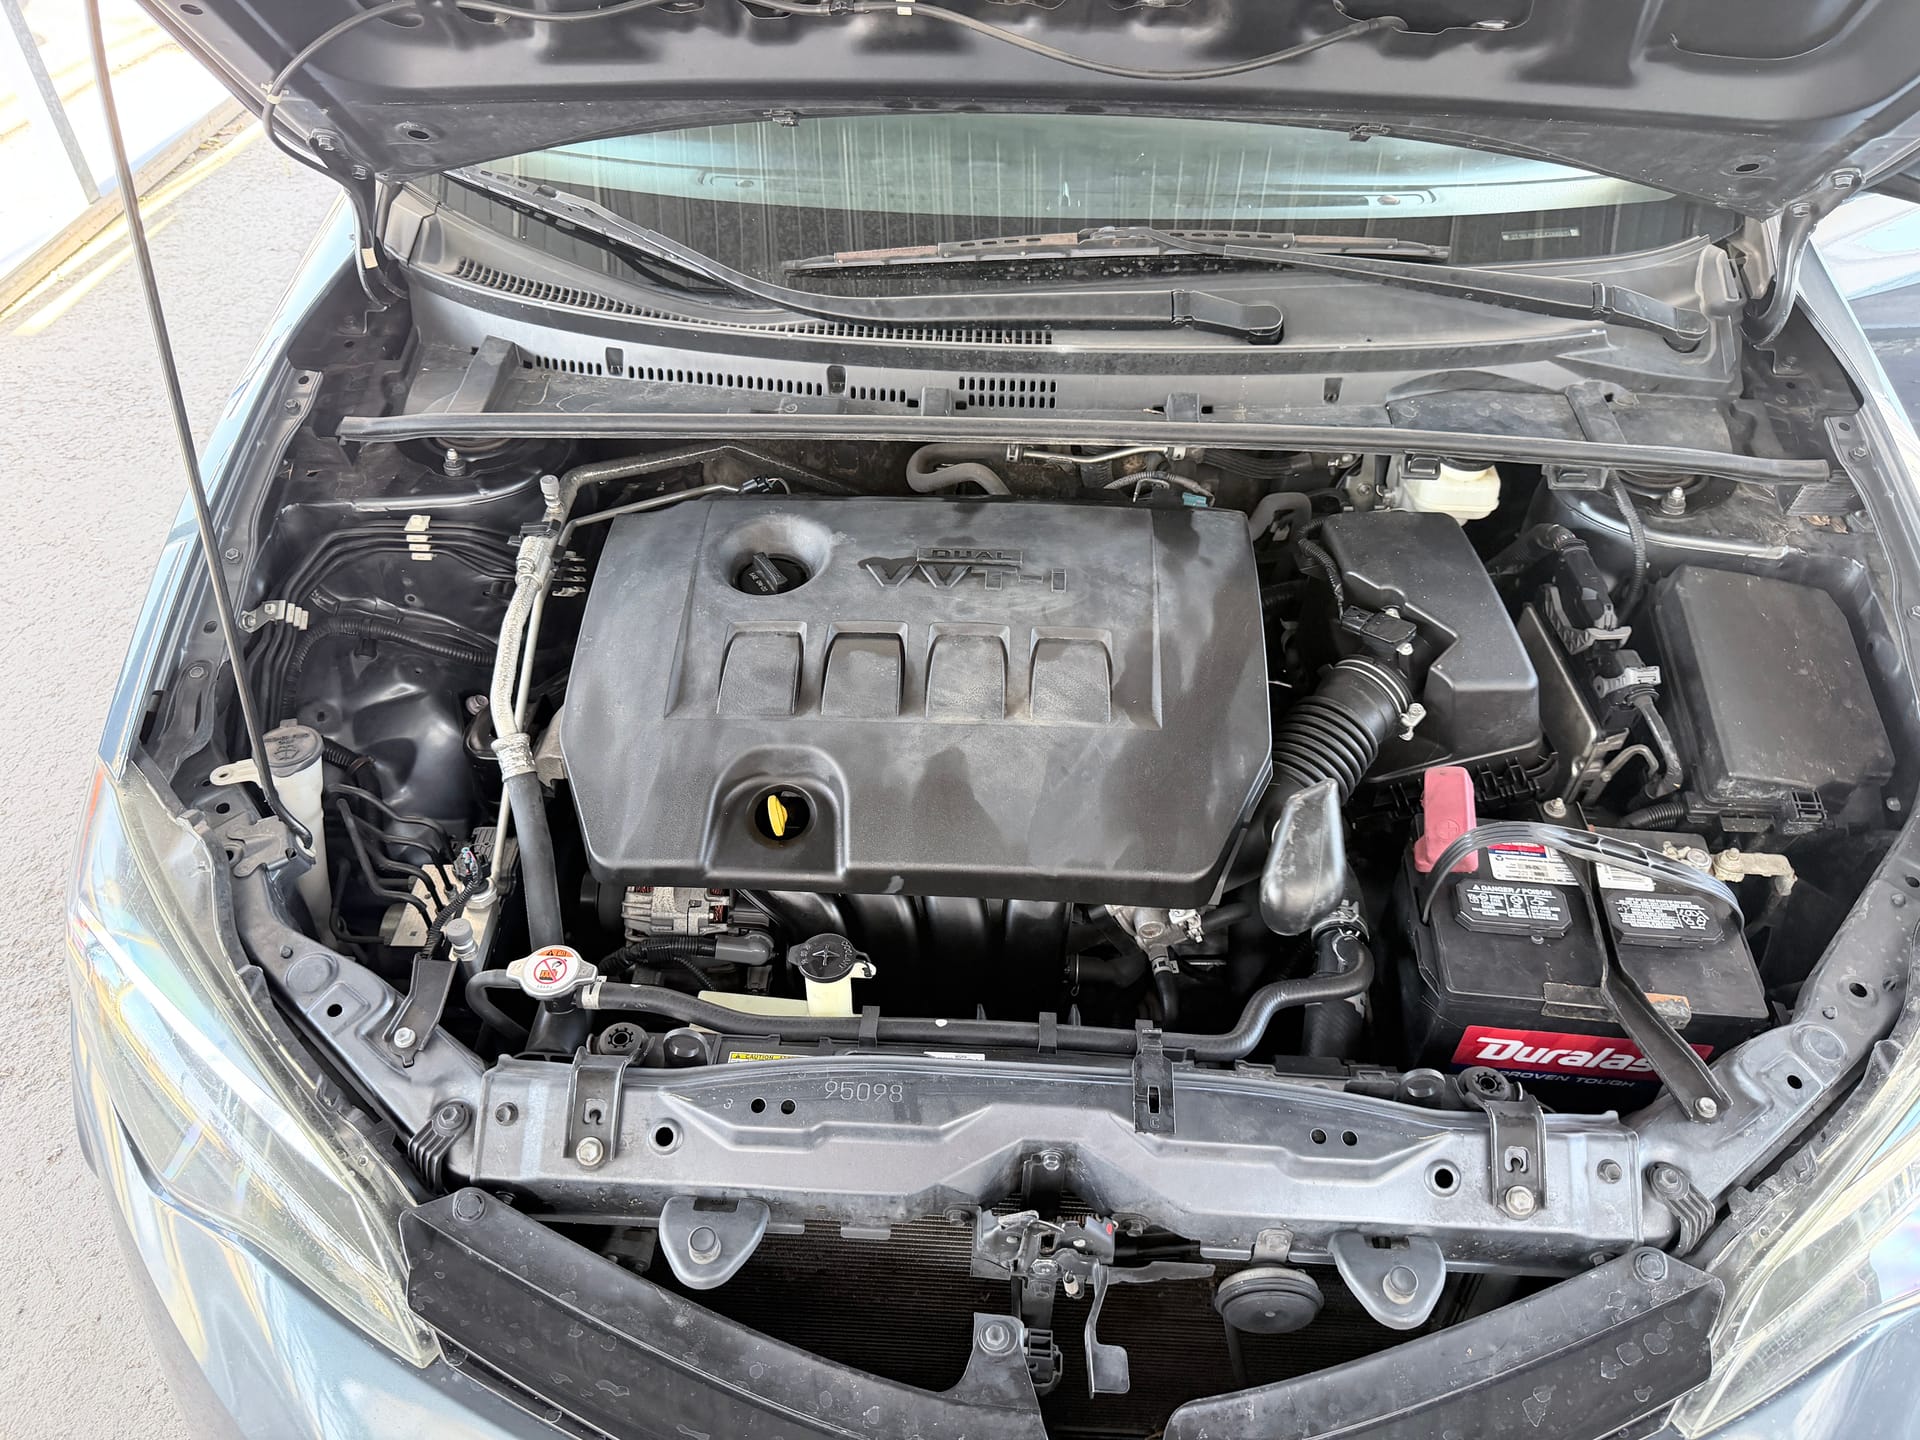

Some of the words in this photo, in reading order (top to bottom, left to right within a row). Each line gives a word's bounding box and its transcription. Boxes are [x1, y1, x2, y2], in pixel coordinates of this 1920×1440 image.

[931, 549, 1013, 560] DUAL
[1481, 885, 1514, 893] DANGER
[1521, 888, 1553, 897] POISON
[745, 1053, 774, 1061] CAUTION
[1476, 1036, 1654, 1073] Duralas
[1500, 1070, 1570, 1081] PROVEN
[1576, 1077, 1636, 1087] TOUGH
[824, 1080, 903, 1103] 95098
